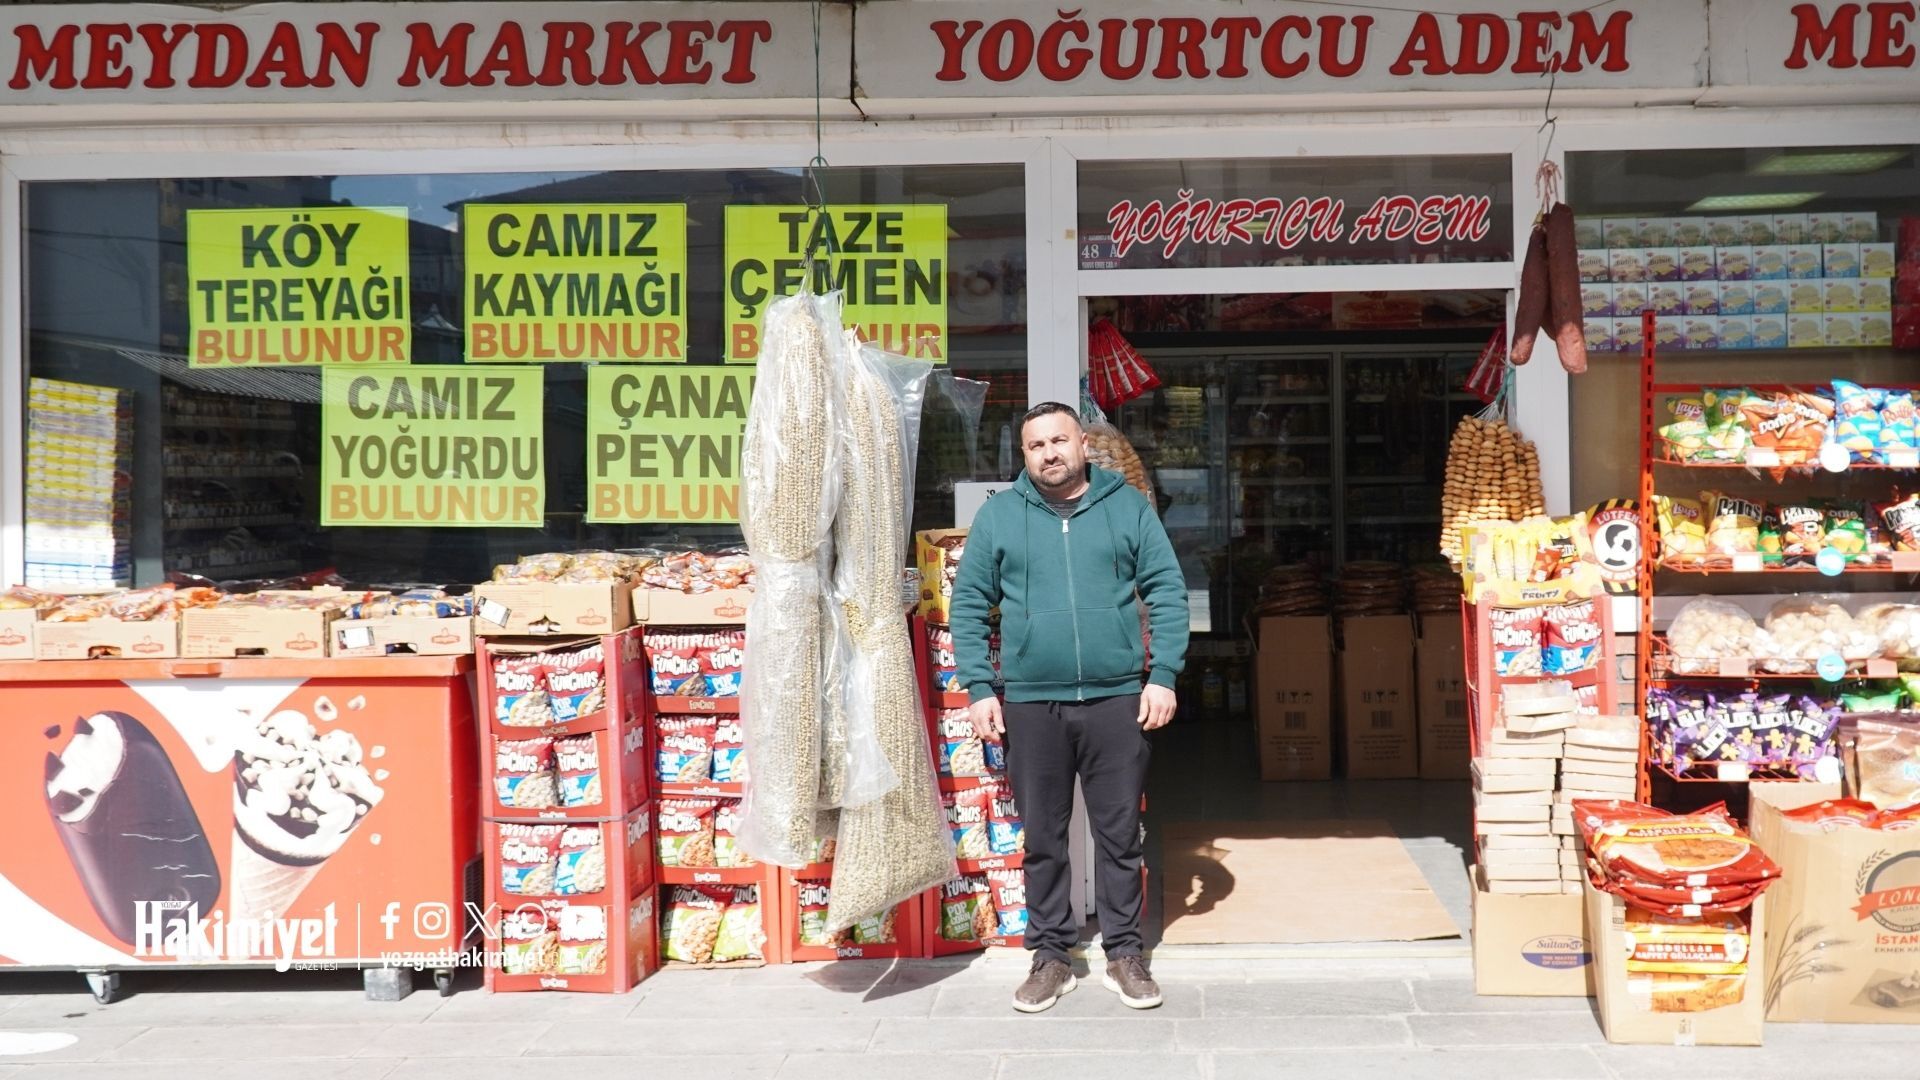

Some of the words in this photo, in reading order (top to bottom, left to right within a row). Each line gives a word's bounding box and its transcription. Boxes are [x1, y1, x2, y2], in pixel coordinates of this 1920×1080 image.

[8, 22, 380, 90] MEYDAN
[397, 20, 772, 88] MARKET
[930, 8, 1374, 82] YOĞURTCU
[1389, 10, 1634, 75] ADEM
[1784, 2, 1920, 69] ME
[241, 214, 360, 268] KÖY
[487, 212, 657, 258] CAMIZ
[779, 212, 904, 254] TAZE
[1107, 188, 1345, 259] YOĞURTCU
[1349, 194, 1492, 245] ADEM
[1081, 243, 1100, 259] 48
[197, 266, 403, 323] TEREYAĞI
[474, 262, 680, 317] KAYMAĞI
[730, 259, 941, 319] ÇEMEN
[197, 326, 405, 364] BULUNUR
[472, 323, 681, 358] BULUNUR
[348, 376, 516, 421] CAMIZ
[332, 424, 538, 480] YOĞURDU
[330, 484, 539, 521] BULUNUR
[595, 484, 740, 520] BULUN
